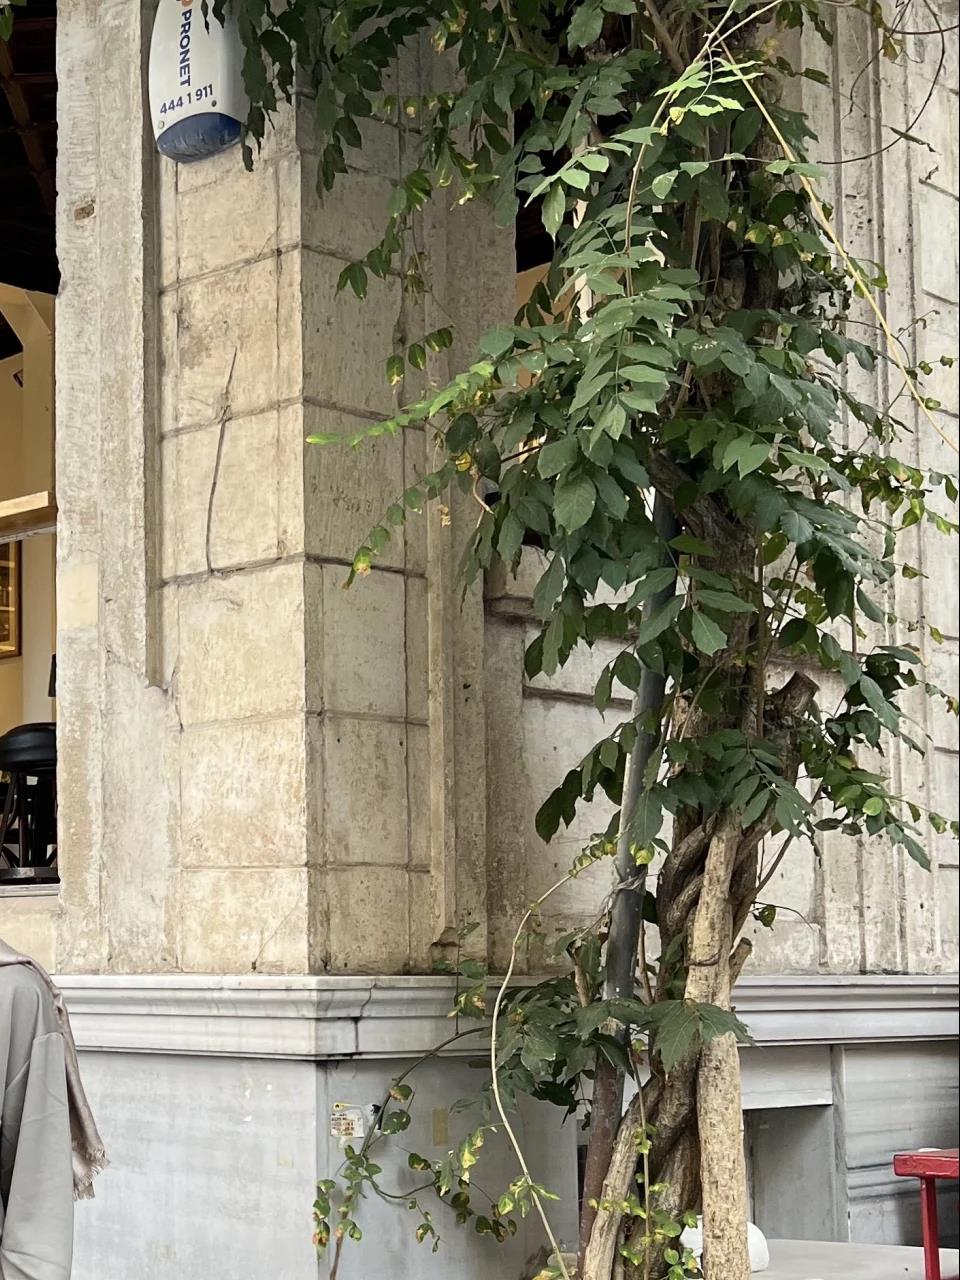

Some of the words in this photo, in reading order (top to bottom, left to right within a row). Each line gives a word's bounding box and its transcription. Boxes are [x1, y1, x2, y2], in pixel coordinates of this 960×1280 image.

[179, 9, 192, 86] PRONET
[160, 96, 183, 114] 444
[195, 84, 213, 101] 911
